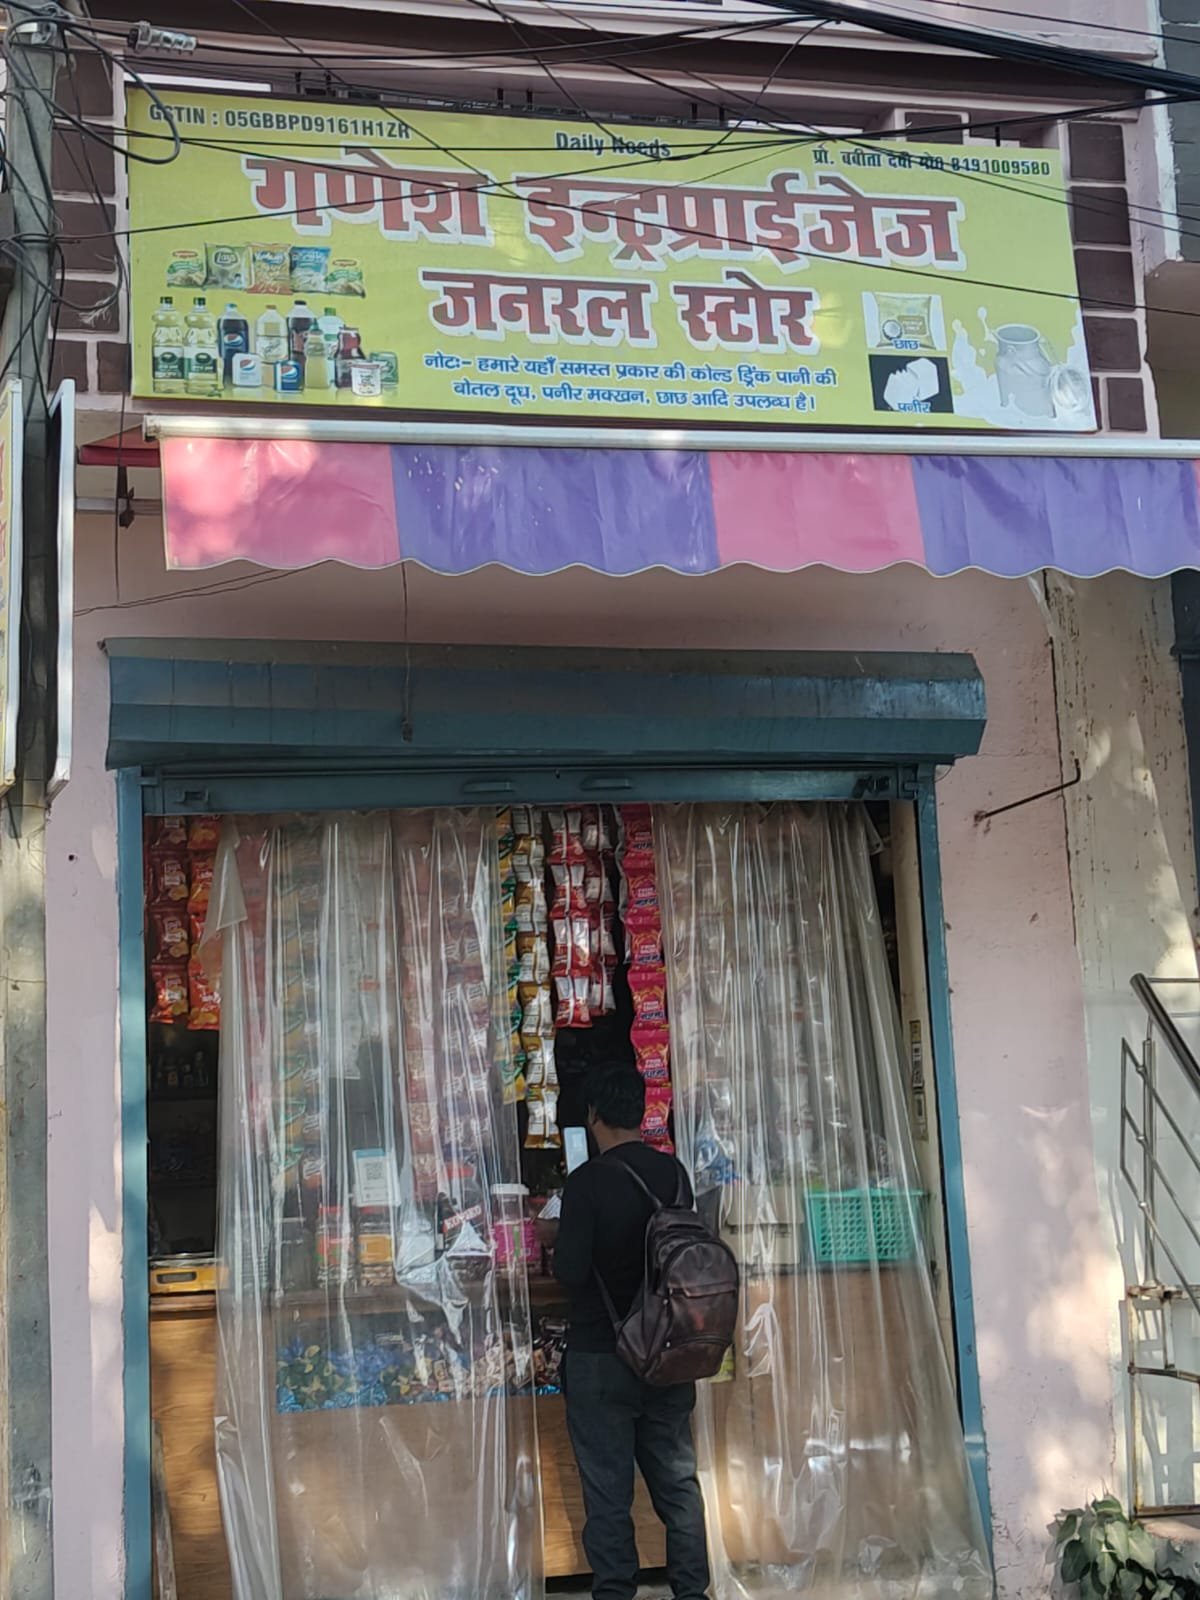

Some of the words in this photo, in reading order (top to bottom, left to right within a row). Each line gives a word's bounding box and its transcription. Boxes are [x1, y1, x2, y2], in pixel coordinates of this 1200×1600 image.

[150, 104, 205, 124] GSTIN
[225, 110, 411, 139] 05GBBPD9161H1ZR
[556, 132, 604, 156] Daily
[612, 136, 671, 158] Needs
[246, 146, 489, 237] गणेश
[422, 271, 650, 339] जनरल
[674, 271, 814, 346] स्टोर
[893, 340, 919, 350] छाछ
[478, 356, 519, 373] हमारे
[524, 357, 555, 375] यहाँ
[560, 363, 610, 376] समस्त
[616, 364, 659, 380] प्रकार
[664, 362, 686, 379] की
[691, 364, 733, 382] कोल्ड
[776, 368, 810, 384] पानी
[815, 369, 837, 385] की
[454, 378, 500, 396] बोतल
[543, 383, 582, 400] पनीर
[656, 391, 687, 405] छाछ
[692, 390, 729, 406] आदि
[898, 400, 930, 413] पनीर
